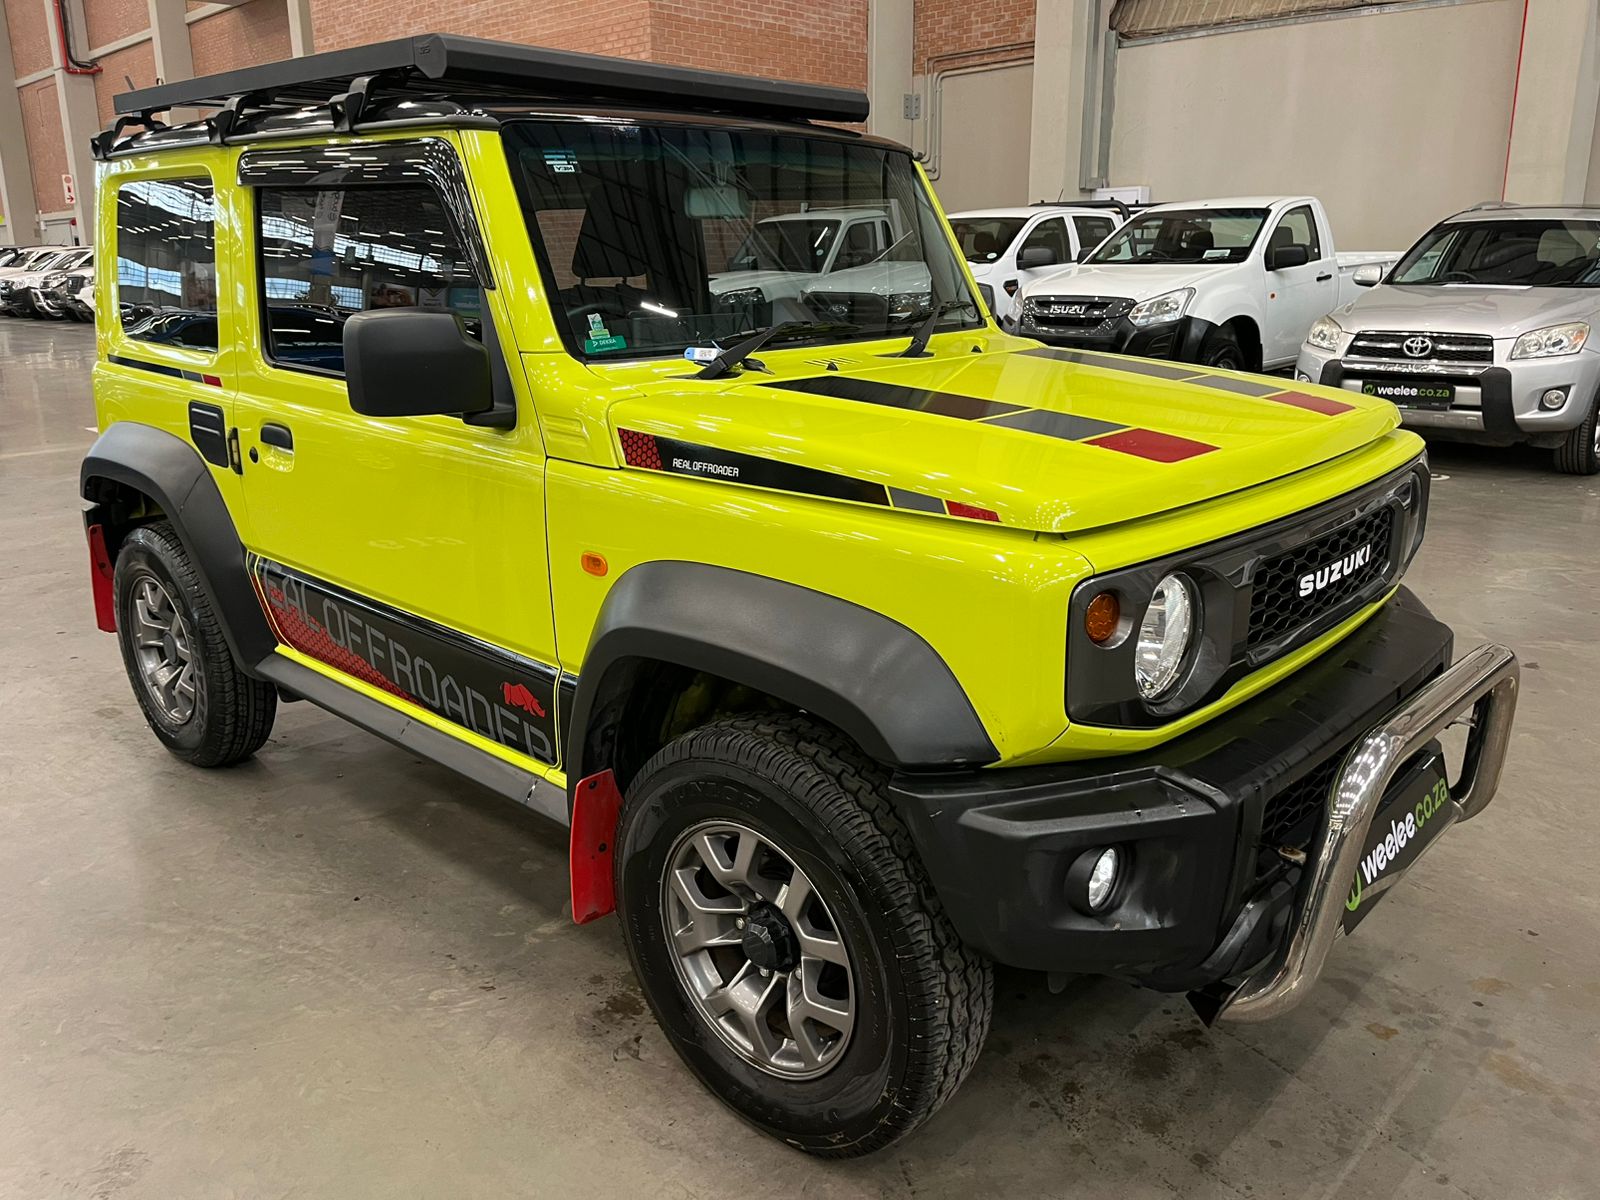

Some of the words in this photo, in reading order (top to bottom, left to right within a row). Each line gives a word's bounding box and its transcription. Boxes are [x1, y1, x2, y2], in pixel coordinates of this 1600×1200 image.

[1049, 304, 1086, 314] ISUZU
[672, 458, 692, 470] REAL
[692, 461, 740, 477] OFFROADER
[1299, 543, 1371, 597] SUZUKI
[322, 598, 555, 765] OFFROADER
[1360, 777, 1449, 885] weelee.co.za
